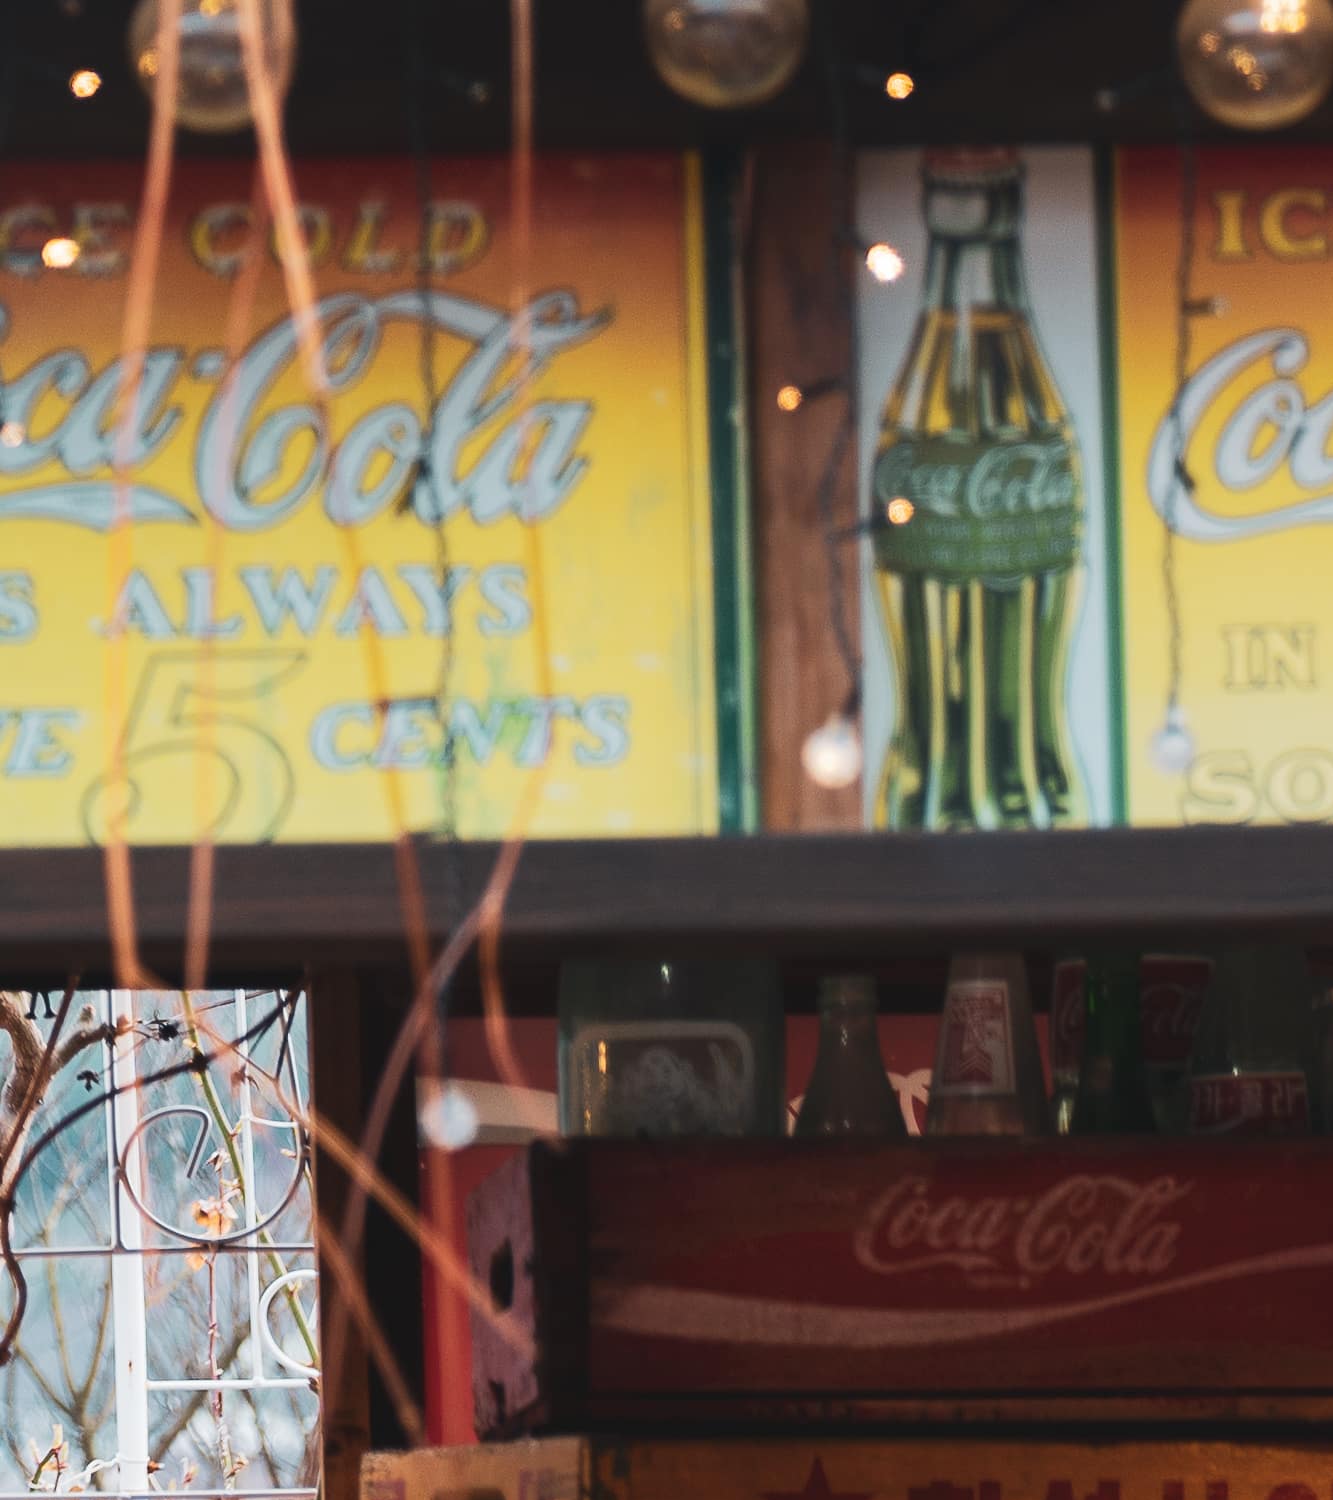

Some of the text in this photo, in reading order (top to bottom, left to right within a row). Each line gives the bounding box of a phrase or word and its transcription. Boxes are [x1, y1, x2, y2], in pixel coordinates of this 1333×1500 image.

[0, 200, 489, 275] CE COLD
[0, 287, 613, 531] ca-Cola
[94, 564, 534, 640] ALWAYS
[1222, 624, 1317, 691] IN
[82, 649, 310, 846] 5
[309, 694, 631, 773] CENTS
[853, 1173, 1197, 1276] Coca-Cola
